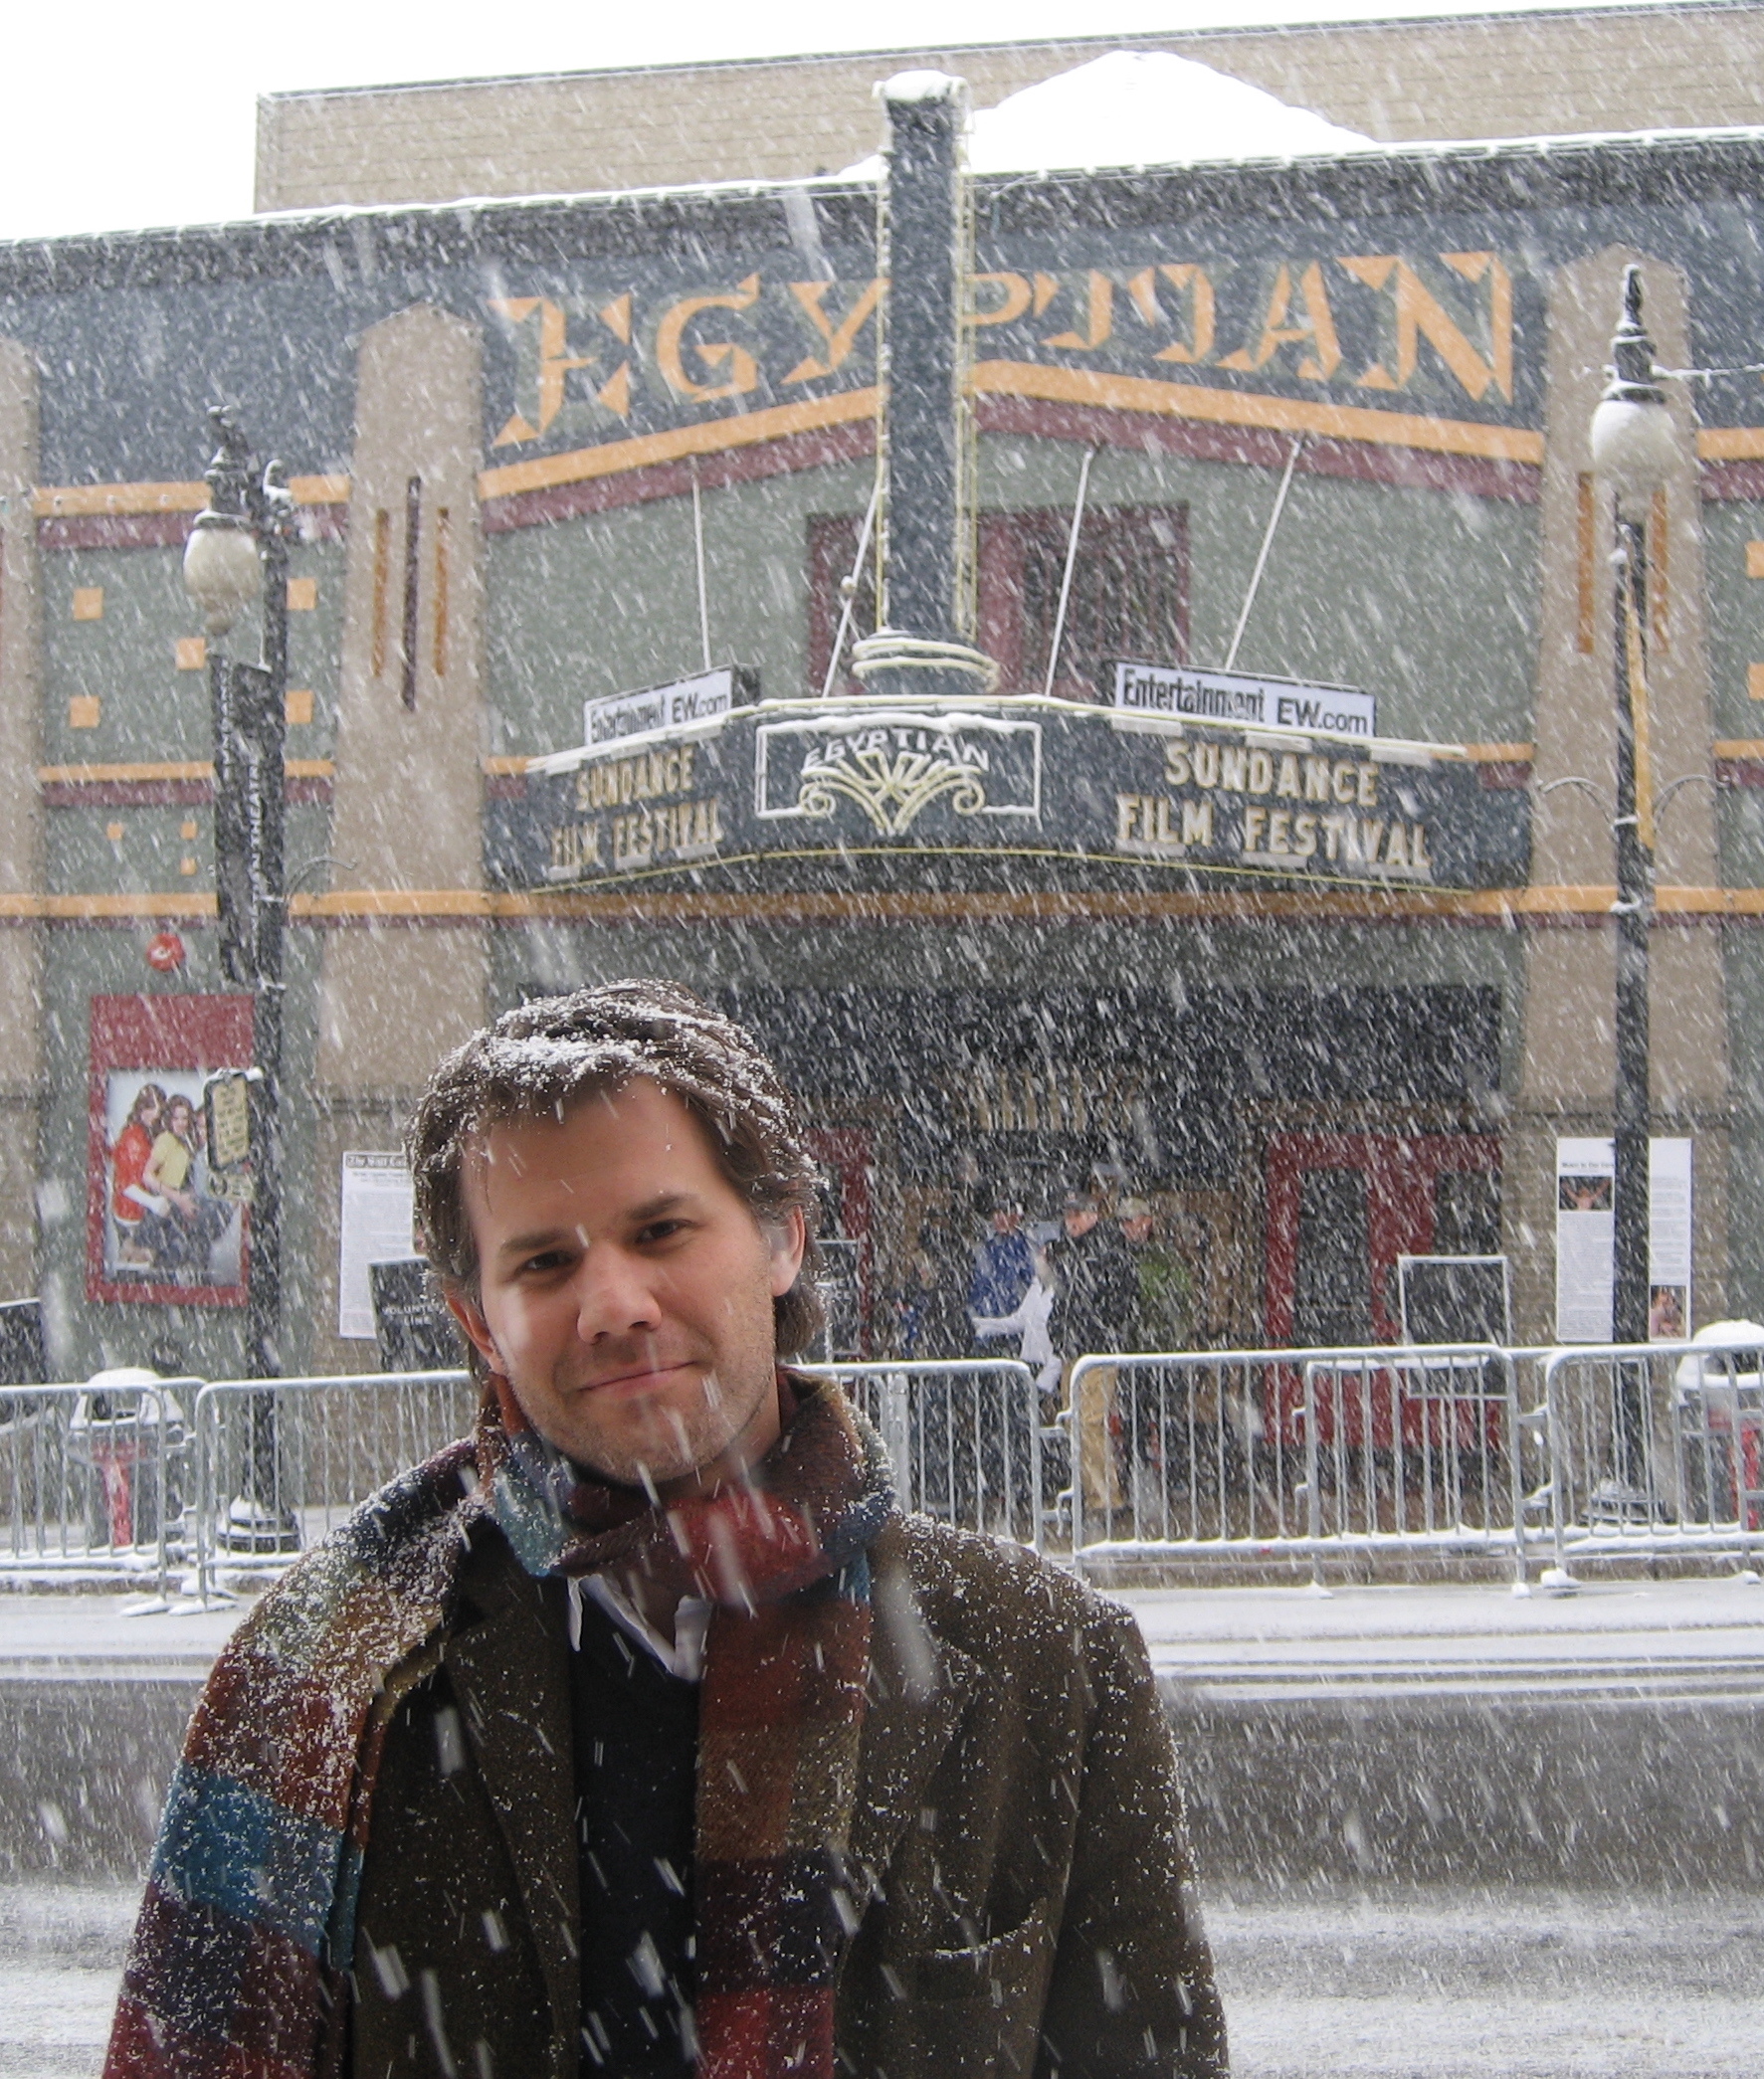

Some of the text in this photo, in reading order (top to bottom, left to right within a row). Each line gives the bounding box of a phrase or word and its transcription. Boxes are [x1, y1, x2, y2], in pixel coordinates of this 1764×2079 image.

[489, 251, 1512, 448] EGYPTIAN
[1122, 667, 1369, 734] Entertainment EW.com
[576, 746, 694, 813] SUNDANCE
[803, 728, 990, 772] EGYPTIAN
[1165, 740, 1380, 807] SUNDANCE
[614, 798, 724, 859] FESTIVAL
[1116, 794, 1432, 868] FILM FESTIVAL
